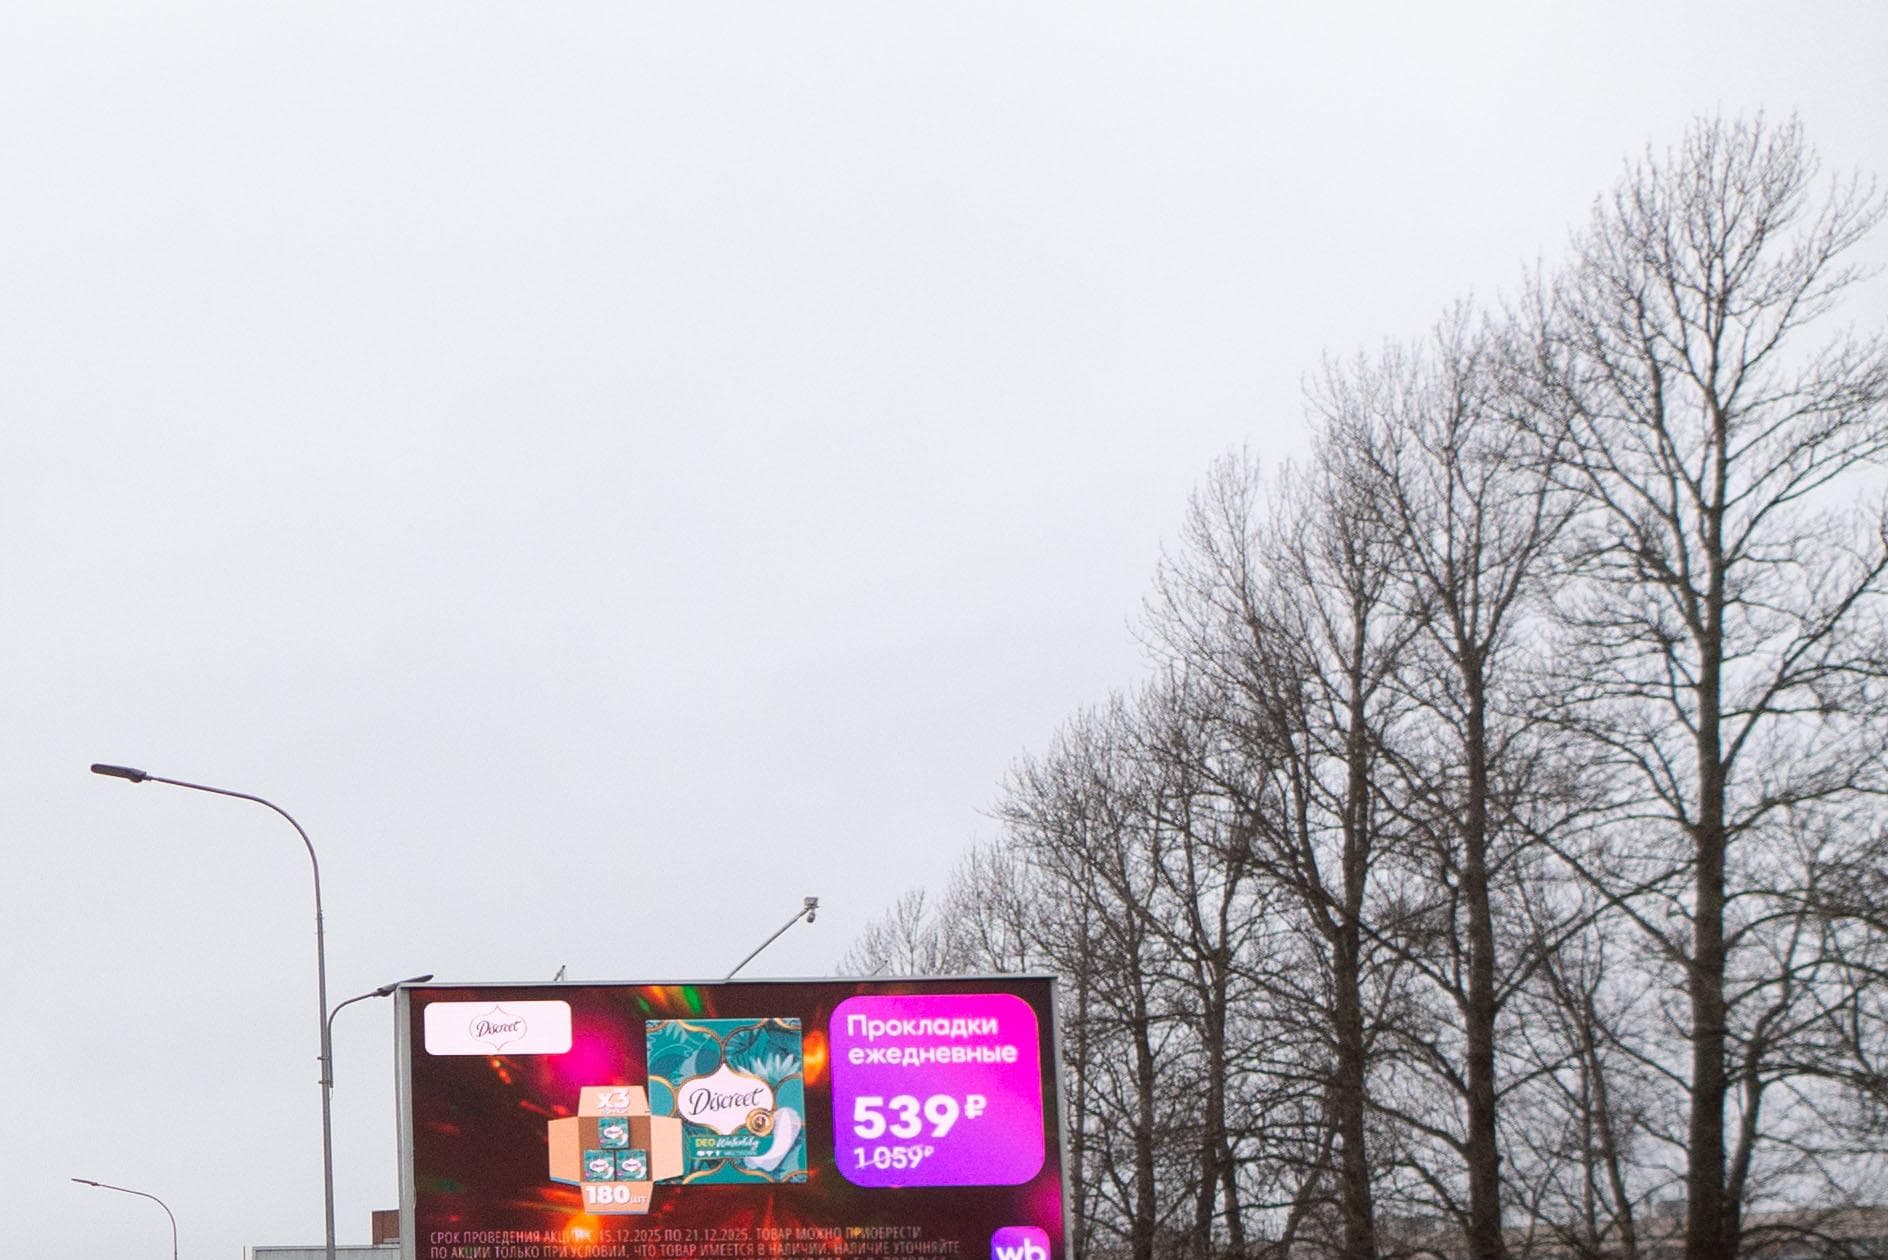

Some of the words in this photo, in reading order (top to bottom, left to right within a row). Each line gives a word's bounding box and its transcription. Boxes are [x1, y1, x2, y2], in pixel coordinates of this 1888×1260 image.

[476, 1020, 522, 1037] Discreet
[847, 1014, 998, 1042] Прокладки
[848, 1045, 1018, 1067] ежедневные
[689, 1088, 764, 1115] Discreet
[431, 1232, 460, 1244] СРОК
[464, 1231, 540, 1245] ПРОВЕДЕНИЯ
[600, 1229, 661, 1242] 15.12.2025
[664, 1229, 682, 1242] ПО
[756, 1228, 792, 1241] ТОВАР
[795, 1227, 841, 1240] МОЖНО
[431, 1247, 447, 1259] ПО
[451, 1246, 490, 1260] АКЦИИ
[494, 1246, 540, 1258] ТОЛЬКО
[544, 1245, 567, 1258] ПРИ
[634, 1244, 656, 1257] ЧТО
[661, 1244, 696, 1257] ТОВАР
[700, 1243, 754, 1256] ИМЕЕТСЯ
[758, 1243, 765, 1256] В
[835, 1241, 888, 1255] НАЛИЧИЕ
[893, 1239, 960, 1255] УТОЧНЯЙТЕ
